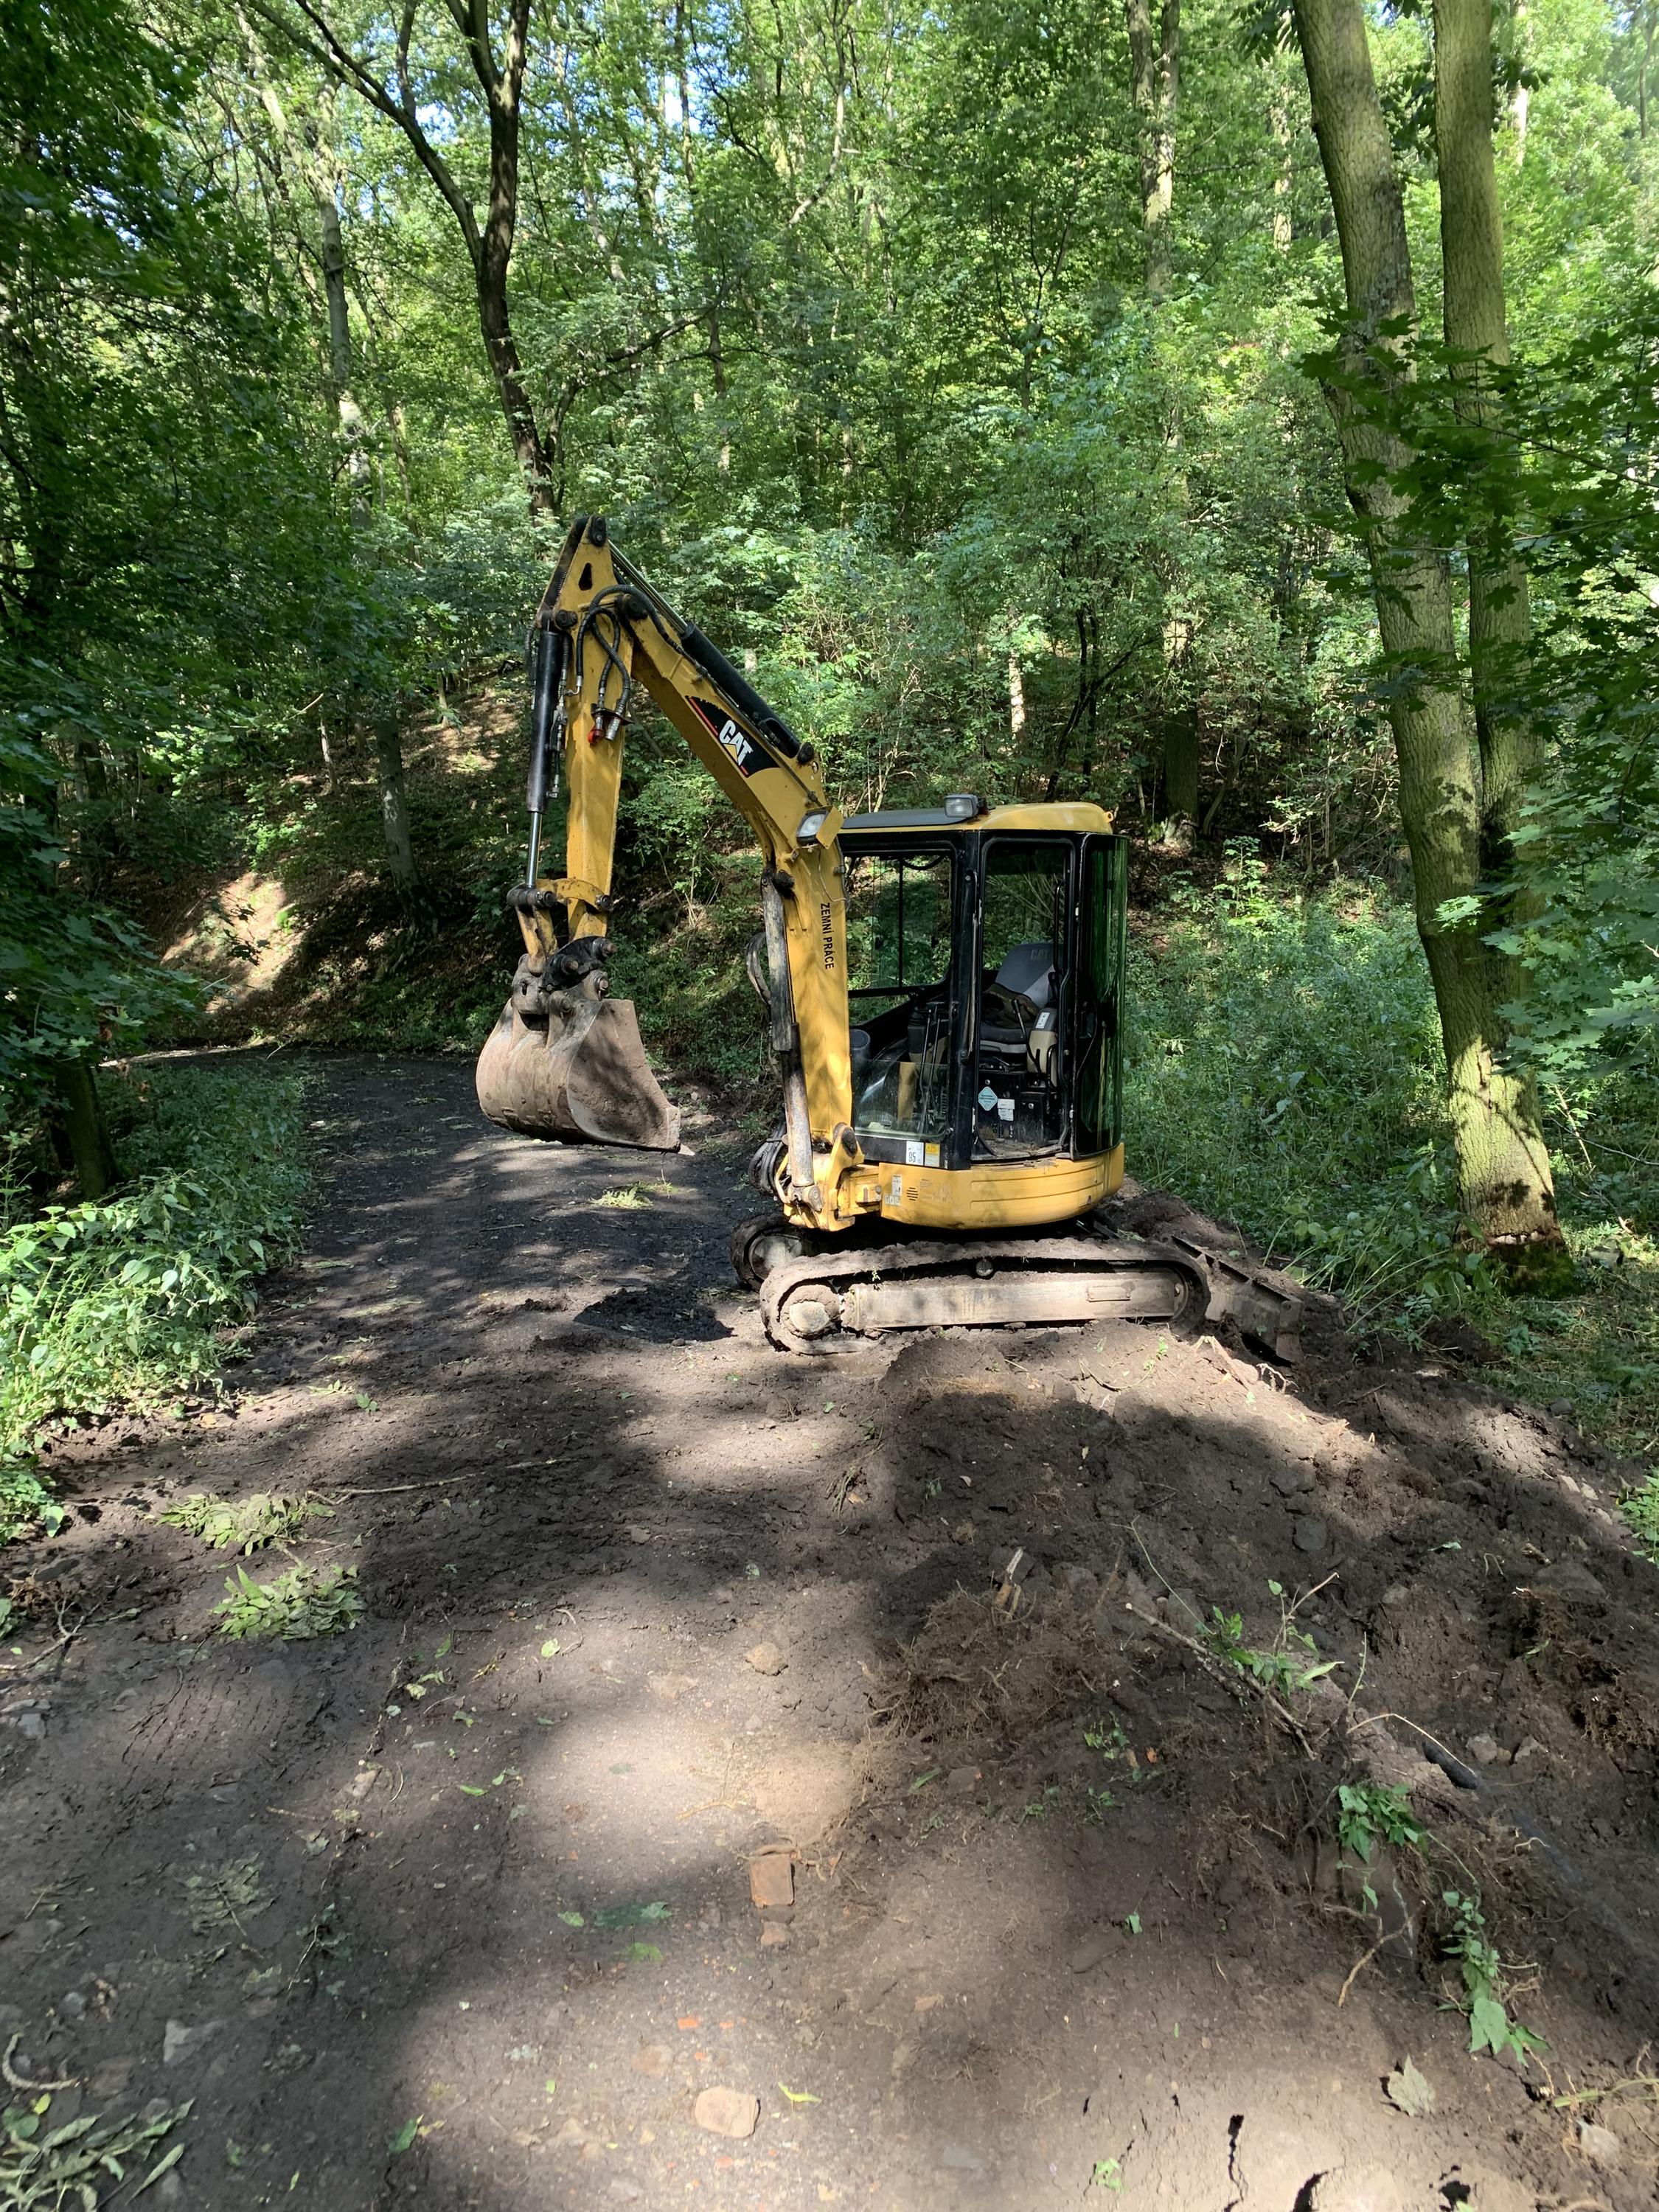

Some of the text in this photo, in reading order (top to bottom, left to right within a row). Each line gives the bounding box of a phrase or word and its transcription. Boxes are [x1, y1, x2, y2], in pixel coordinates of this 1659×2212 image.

[719, 720, 754, 766] CAT
[821, 902, 835, 970] ZEMNÍ PRÁCE
[908, 1152, 917, 1163] 95
